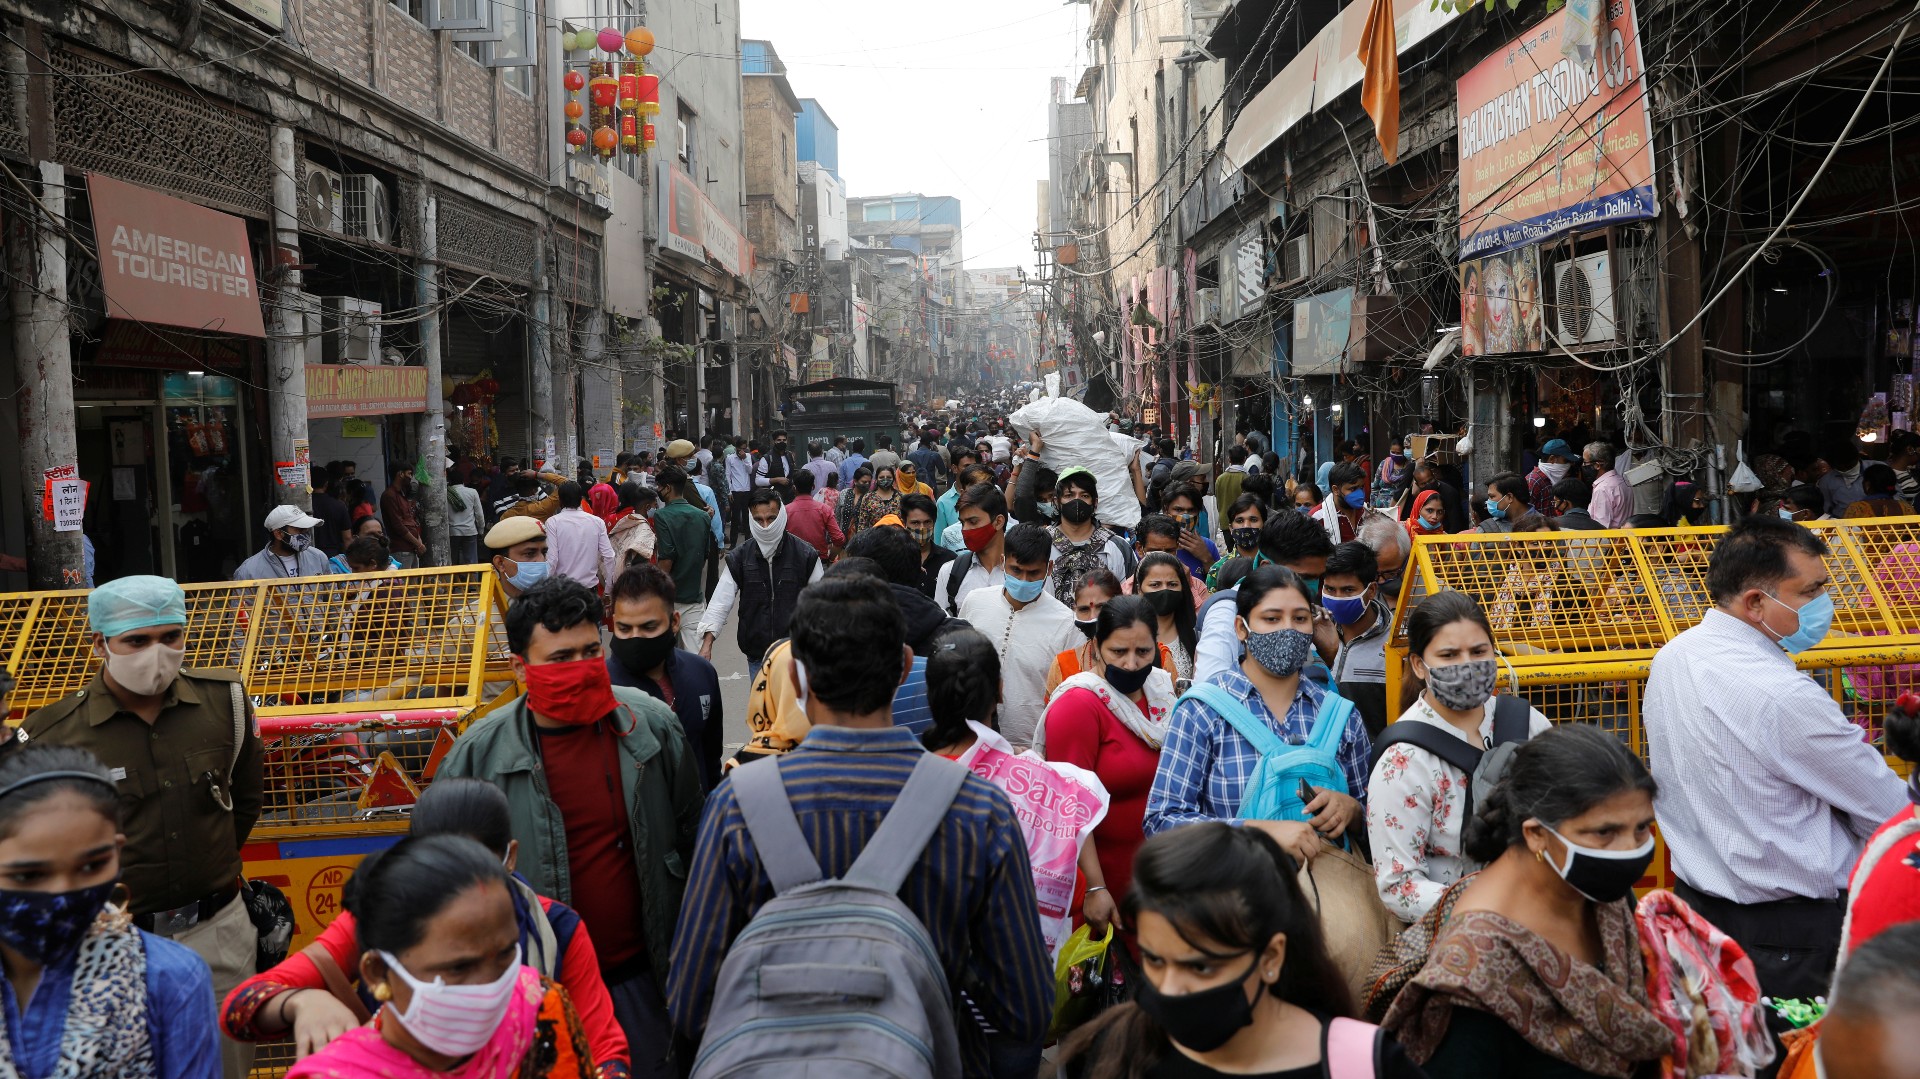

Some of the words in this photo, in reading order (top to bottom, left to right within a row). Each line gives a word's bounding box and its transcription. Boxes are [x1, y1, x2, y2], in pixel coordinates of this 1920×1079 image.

[1461, 79, 1532, 161] BALKRISHAN
[1517, 150, 1530, 165] Gas
[1503, 228, 1523, 244] Main
[1605, 196, 1631, 217] Delhi
[111, 225, 246, 275] AMERICAN
[111, 250, 249, 298] TOURISTER
[337, 367, 364, 400] SINGH
[407, 369, 427, 398] SONS
[1005, 764, 1092, 825] Saree
[322, 870, 343, 885] ND
